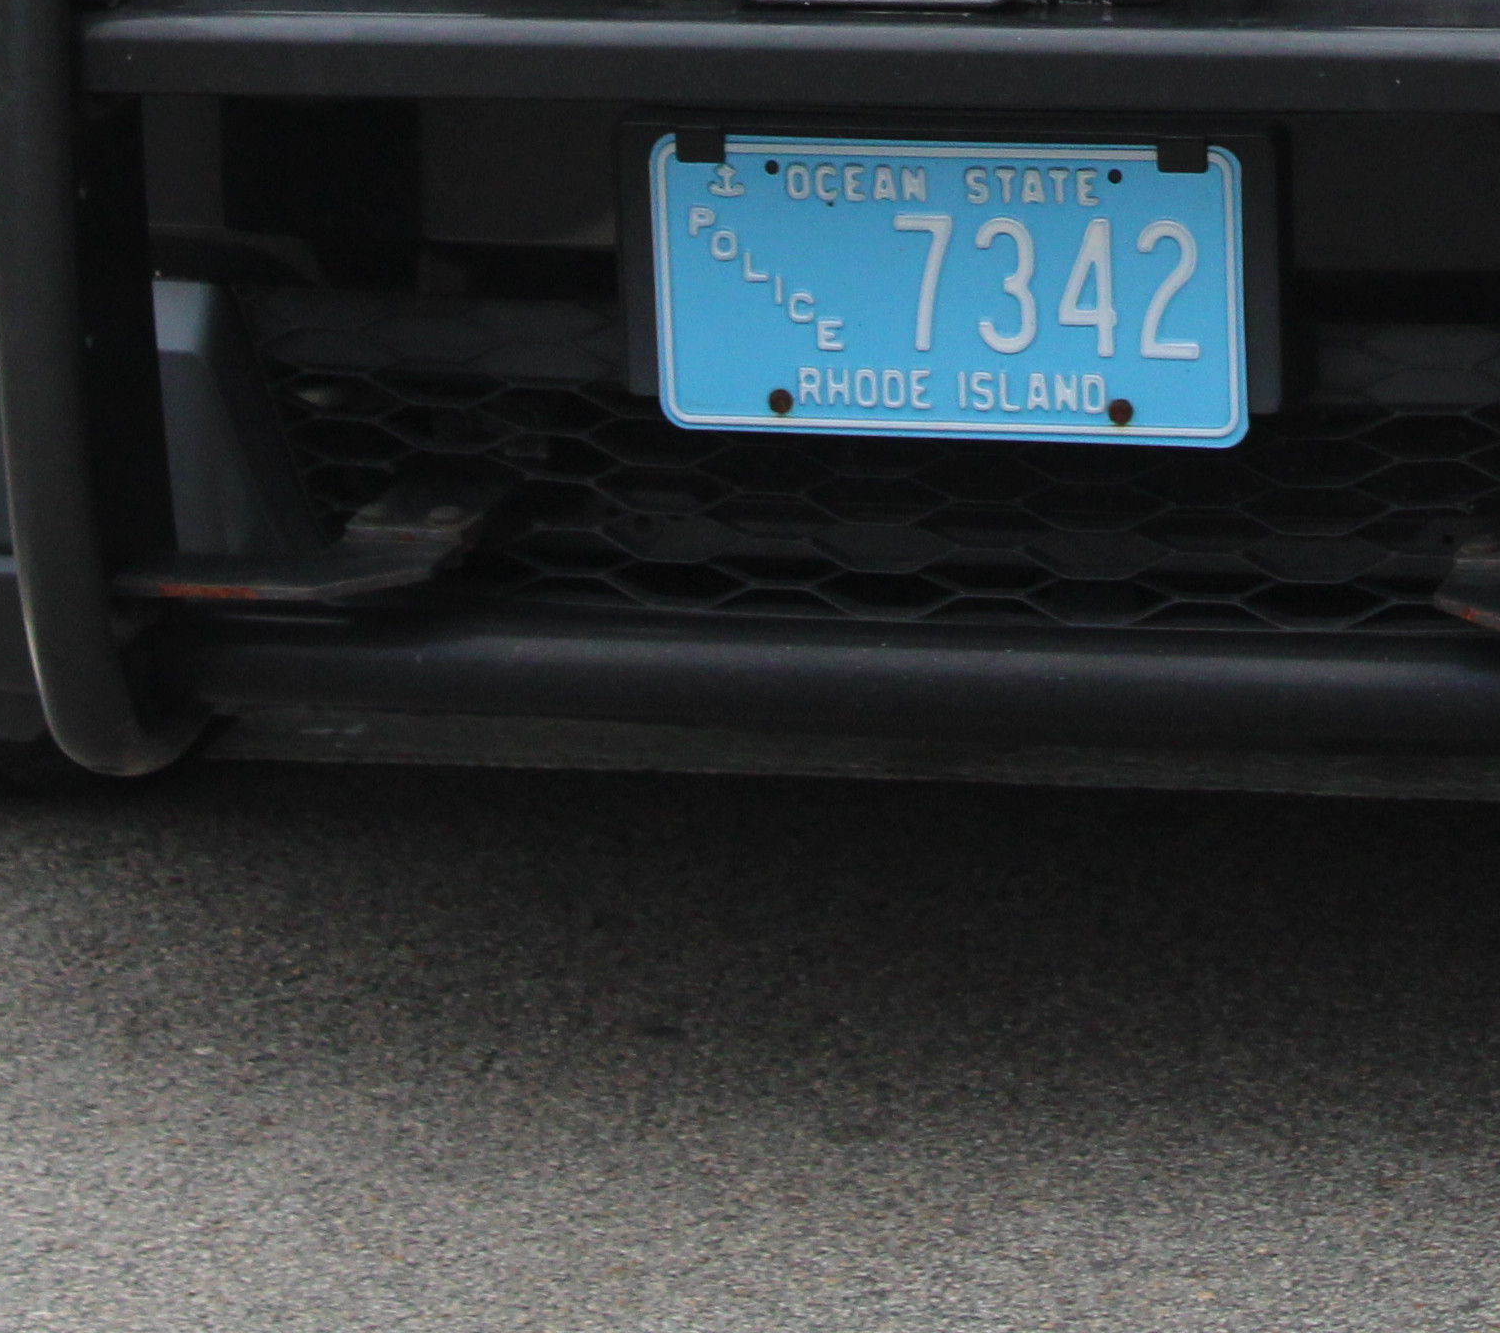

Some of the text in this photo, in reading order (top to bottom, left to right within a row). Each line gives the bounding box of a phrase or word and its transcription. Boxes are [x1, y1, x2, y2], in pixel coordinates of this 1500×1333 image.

[786, 164, 1102, 207] OCEAN STATE
[687, 206, 845, 352] POLICE
[892, 214, 1202, 361] 7342
[797, 366, 1108, 414] RHODE ISLAND
